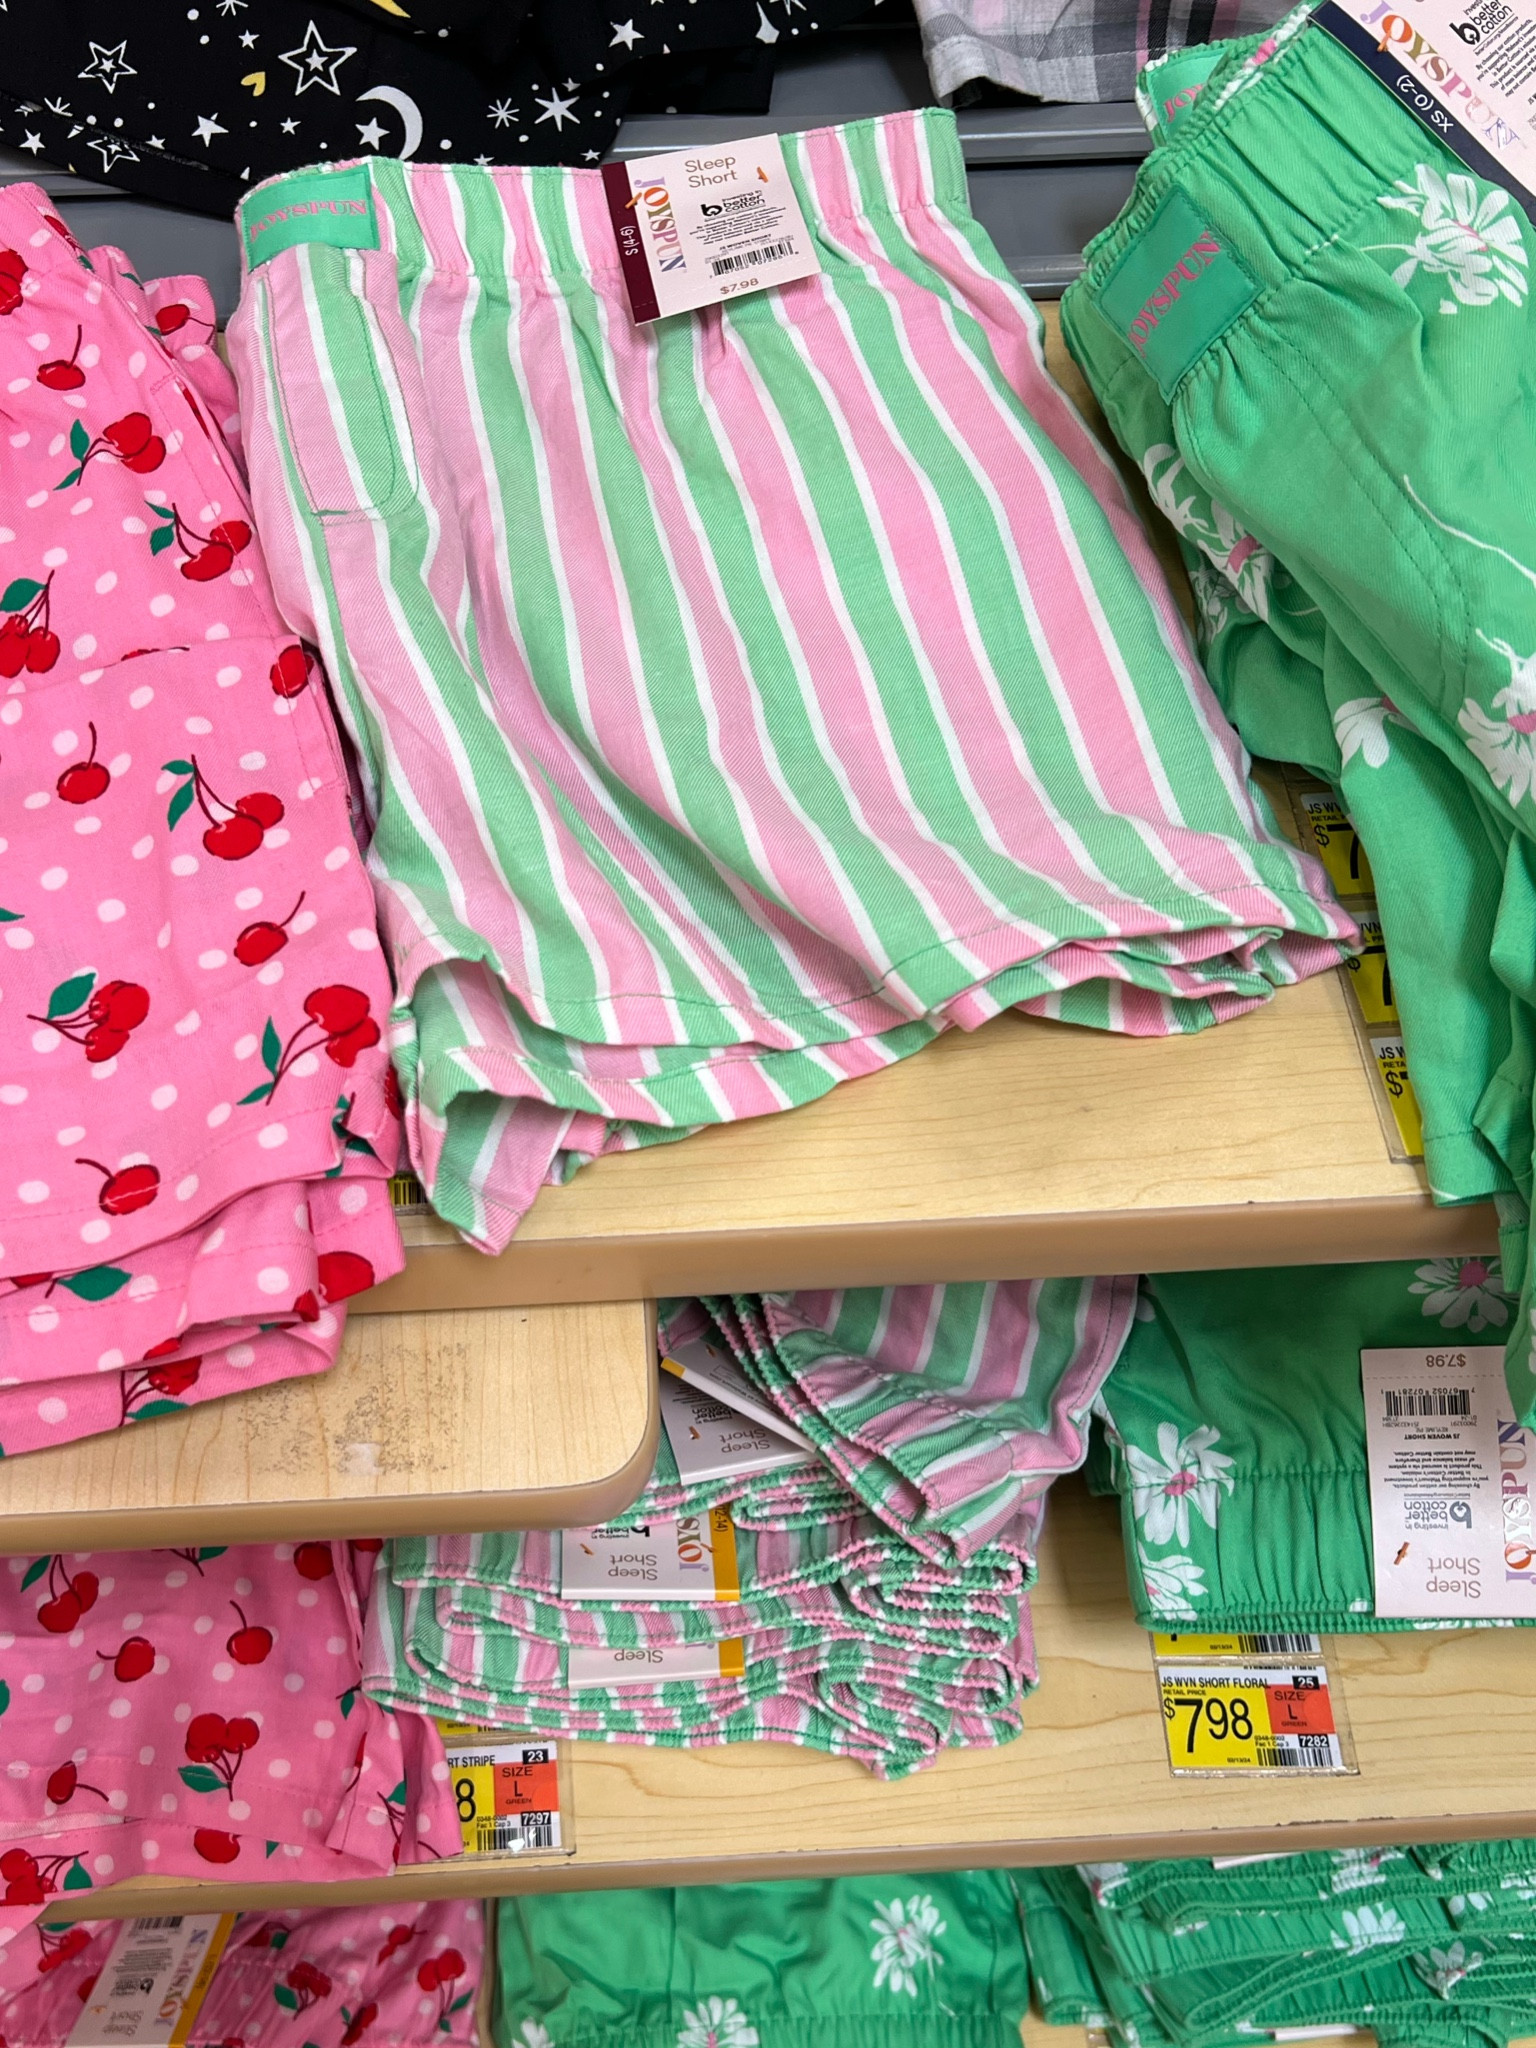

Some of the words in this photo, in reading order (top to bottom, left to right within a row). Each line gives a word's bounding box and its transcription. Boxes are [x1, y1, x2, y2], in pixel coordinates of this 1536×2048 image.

[1481, 5, 1513, 34] cotton
[1396, 75, 1434, 110] (0-2)
[1431, 110, 1454, 133] XS
[685, 157, 736, 173] Sleep
[688, 170, 737, 188] Short
[723, 193, 761, 207] better
[724, 198, 765, 212] cotton
[250, 200, 367, 243] JOYSPUN
[634, 176, 687, 272] JOYSPUN
[720, 278, 759, 295] $7.98
[1128, 230, 1221, 359] JOYSPUN
[1308, 802, 1322, 814] JS
[1380, 1046, 1395, 1059] JS
[1425, 1353, 1466, 1367] $7.98
[719, 1429, 766, 1443] Short
[721, 1440, 770, 1453] Sleep
[1403, 1500, 1447, 1512] cotton
[1406, 1509, 1447, 1522] better
[1413, 1519, 1448, 1529] investing
[610, 1554, 657, 1566] Short
[1428, 1557, 1480, 1575] Short
[608, 1568, 658, 1581] Sleep
[1427, 1577, 1481, 1598] Sleep
[613, 1648, 664, 1663] Sleep
[1162, 1677, 1174, 1687] JS
[1175, 1677, 1197, 1688] WVN
[1199, 1677, 1230, 1688] SHORT
[1233, 1677, 1271, 1689] FLORAL
[1297, 1677, 1314, 1688] 25
[1274, 1691, 1306, 1701] SIZE
[1288, 1704, 1297, 1720] L
[1301, 1736, 1328, 1747] 7282
[462, 1755, 496, 1768] STRIPE
[527, 1751, 544, 1762] 23
[502, 1766, 533, 1778] SIZE
[514, 1781, 523, 1797] L
[456, 1778, 476, 1822] 8
[523, 1812, 550, 1825] 7297
